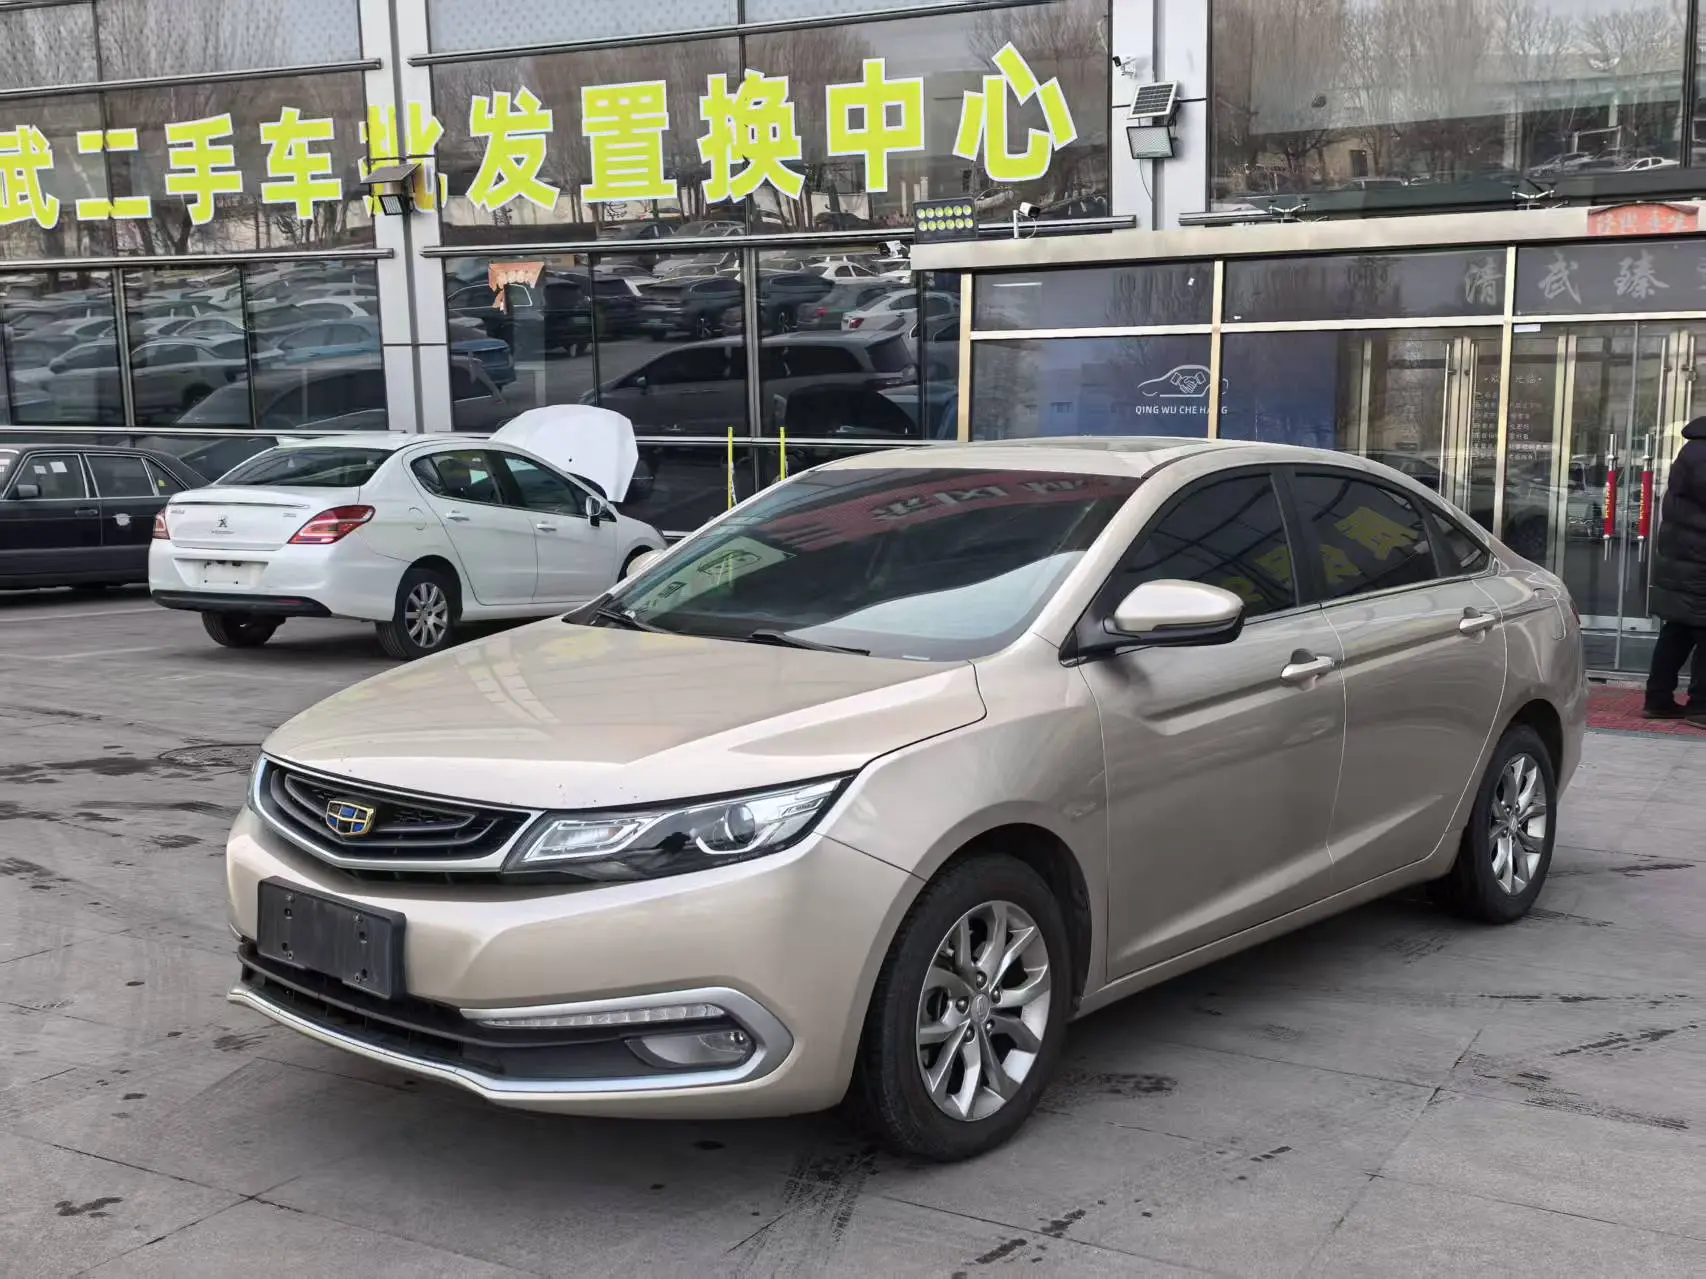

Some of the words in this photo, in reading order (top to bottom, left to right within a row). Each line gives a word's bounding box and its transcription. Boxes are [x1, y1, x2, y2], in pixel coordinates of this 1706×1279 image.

[1135, 405, 1159, 415] QING
[1161, 405, 1177, 415] WU
[1179, 405, 1198, 415] CHE
